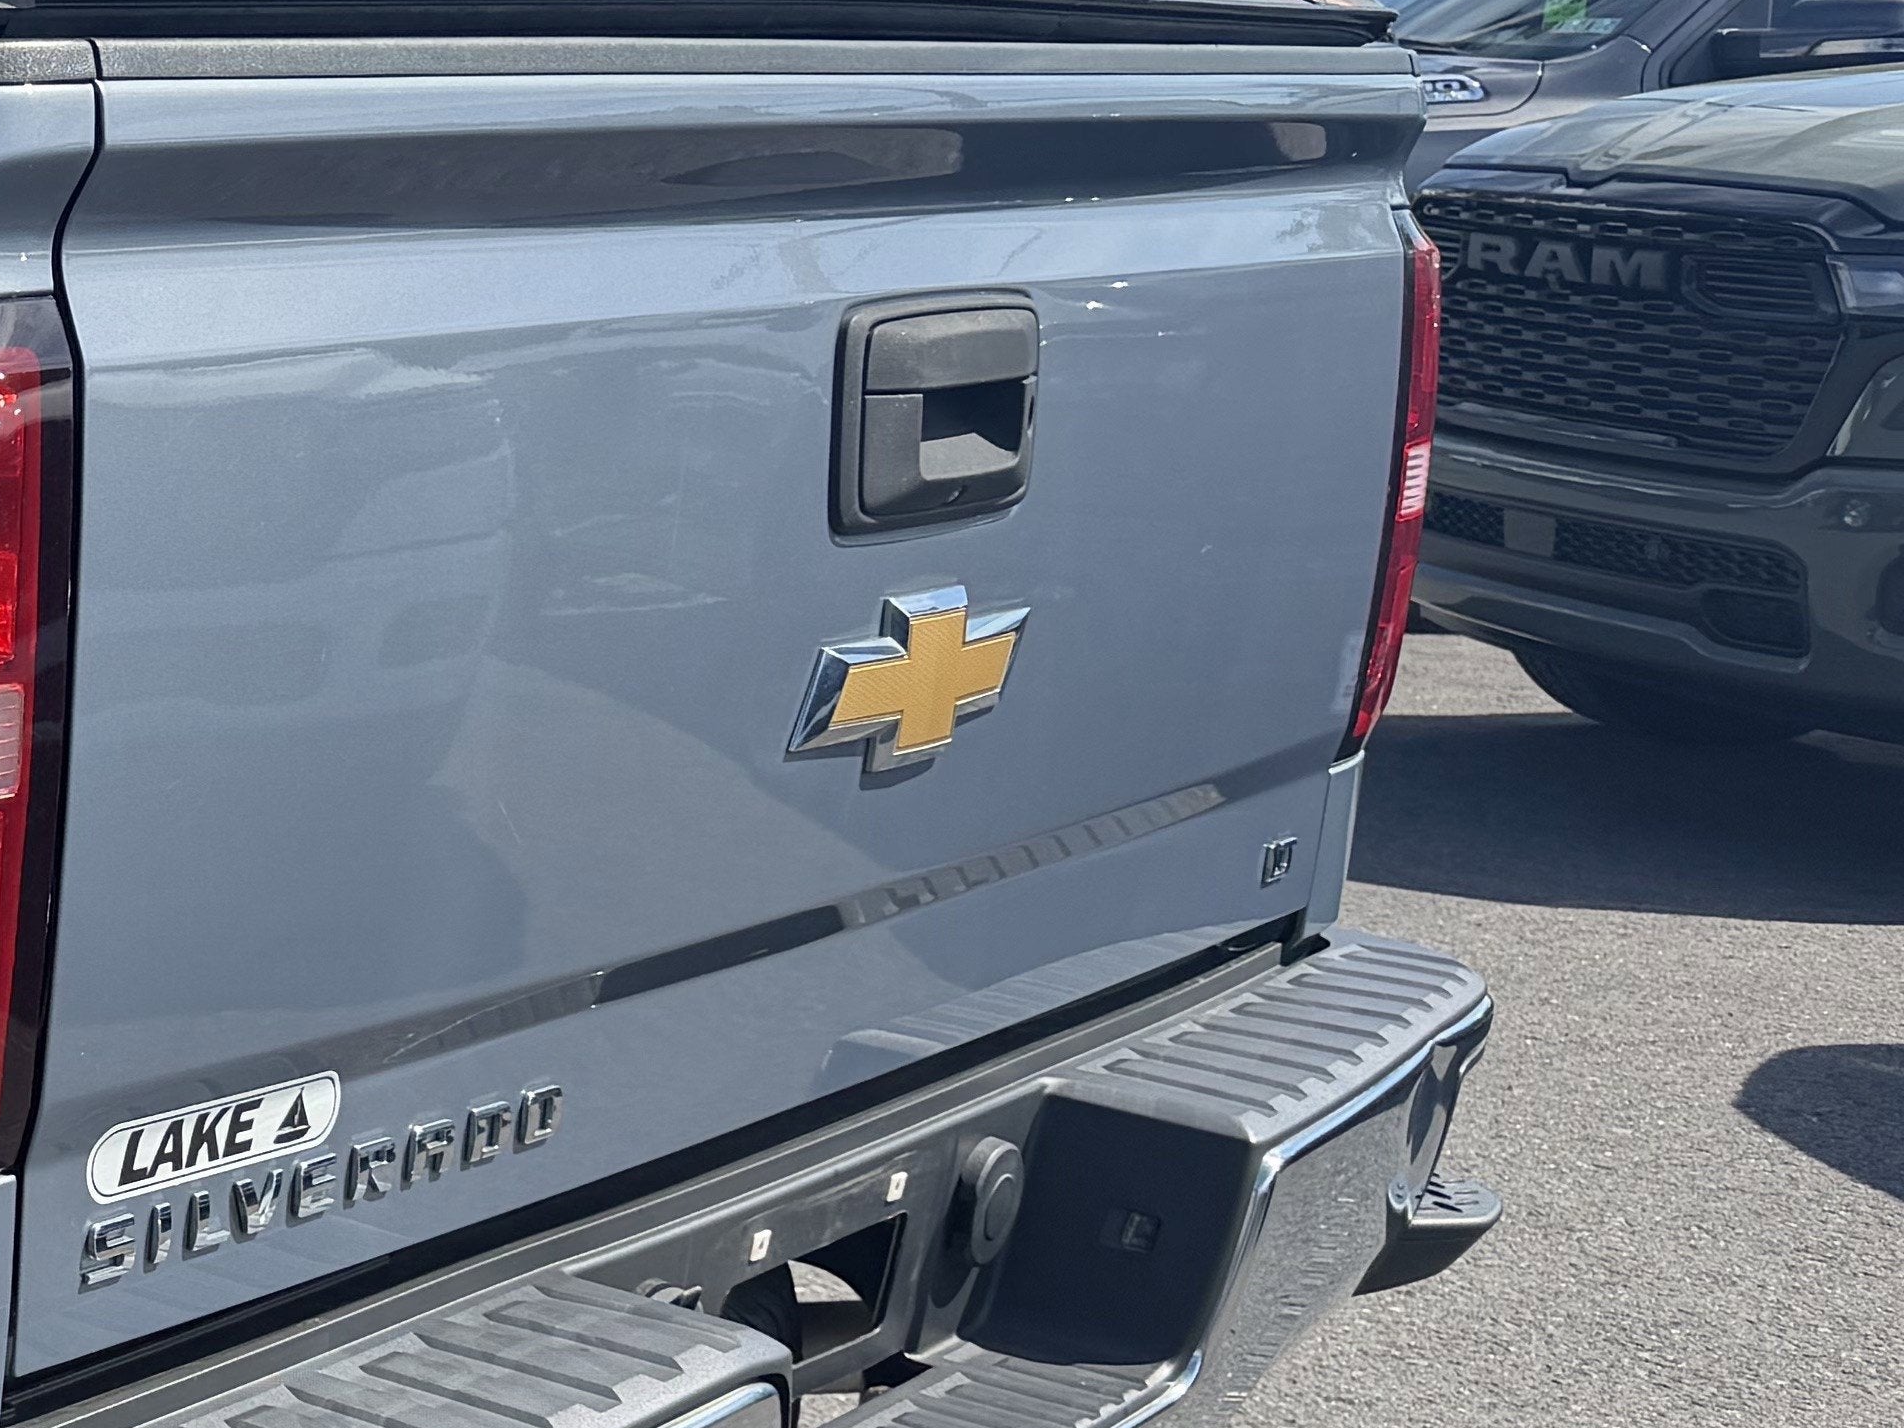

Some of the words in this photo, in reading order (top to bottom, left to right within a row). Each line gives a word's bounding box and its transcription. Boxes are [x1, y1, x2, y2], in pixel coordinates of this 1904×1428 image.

[1467, 231, 1666, 291] RAM
[1262, 836, 1298, 886] LT
[118, 1097, 264, 1187] LAKE
[81, 1085, 563, 1286] SILVERADO
